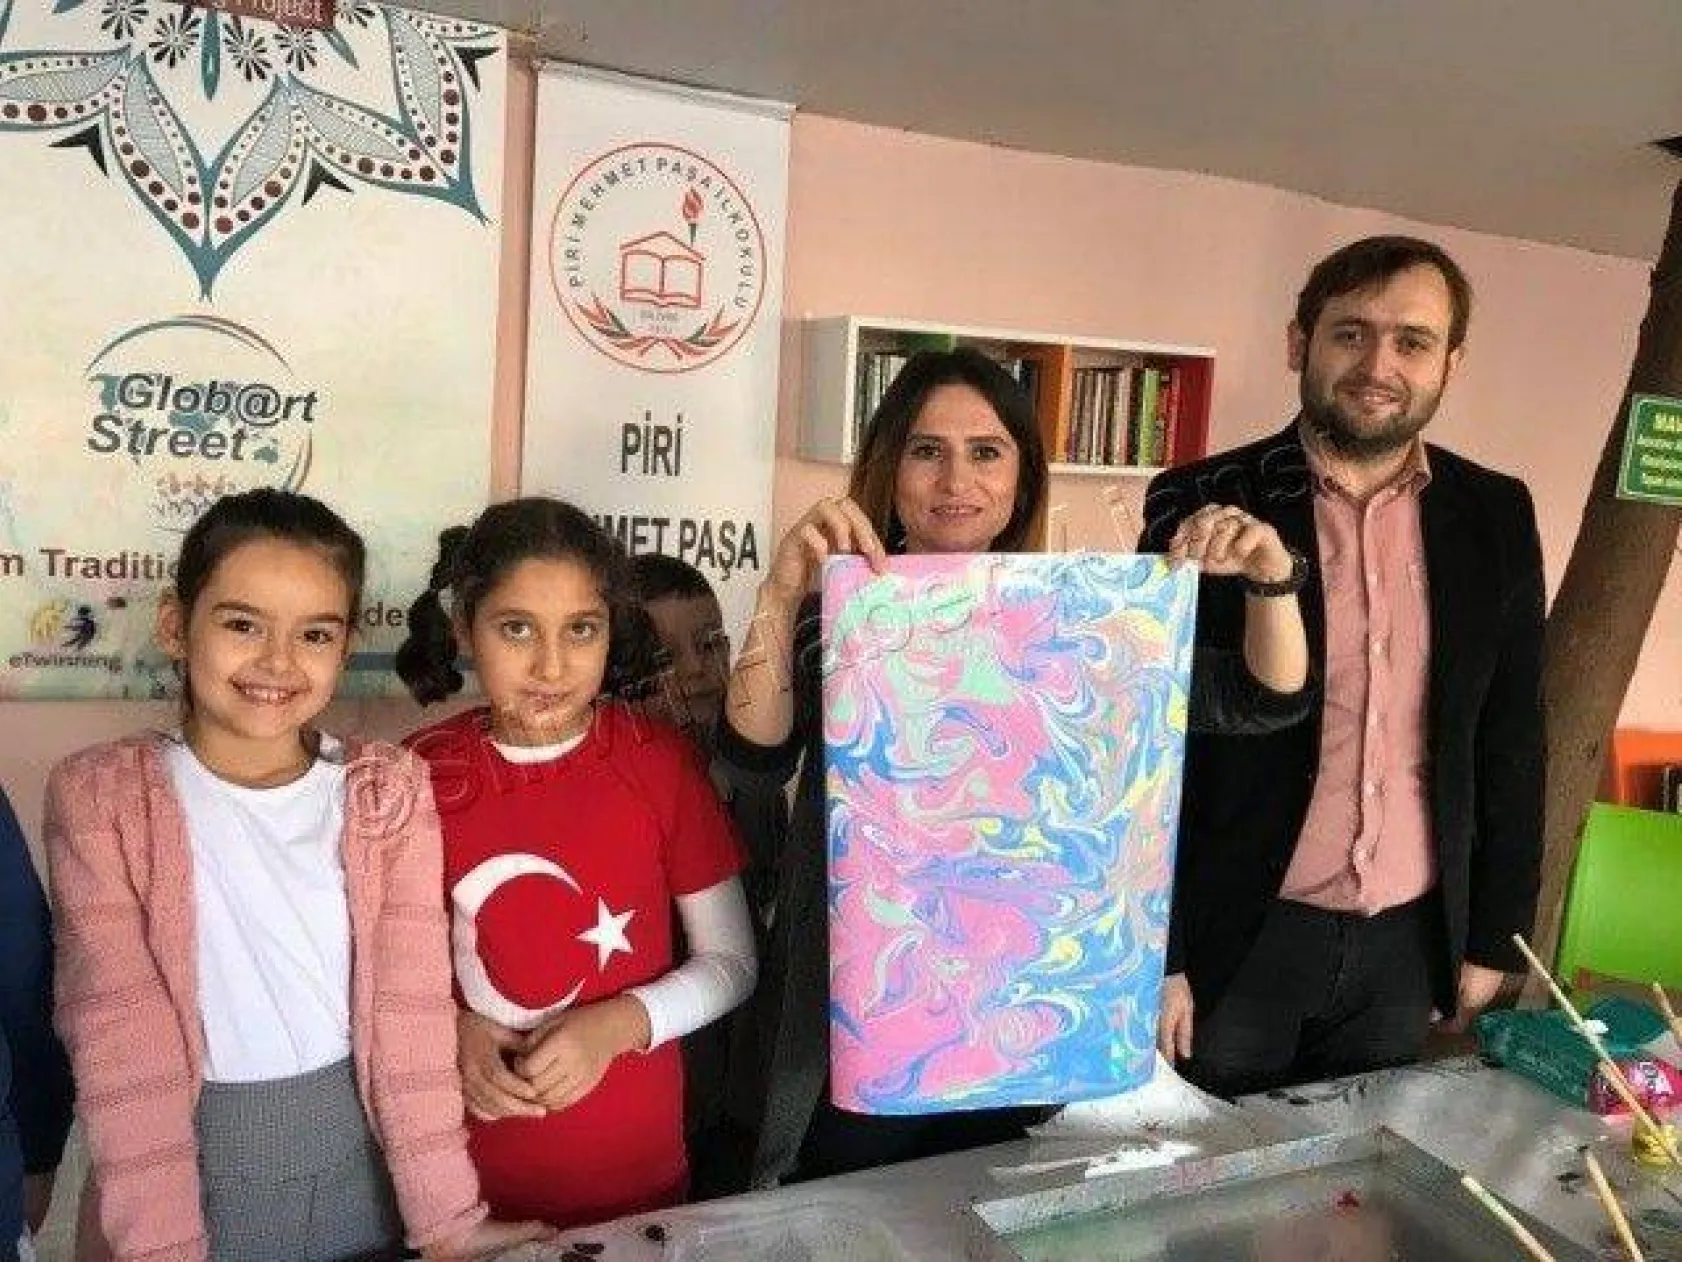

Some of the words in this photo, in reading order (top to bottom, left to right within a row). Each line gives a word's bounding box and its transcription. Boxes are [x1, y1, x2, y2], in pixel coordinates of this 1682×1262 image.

[119, 372, 318, 427] Glob@rt
[87, 413, 243, 461] Street
[620, 409, 683, 477] PİRİ
[594, 514, 671, 557] MET
[679, 516, 760, 581] PAŞA
